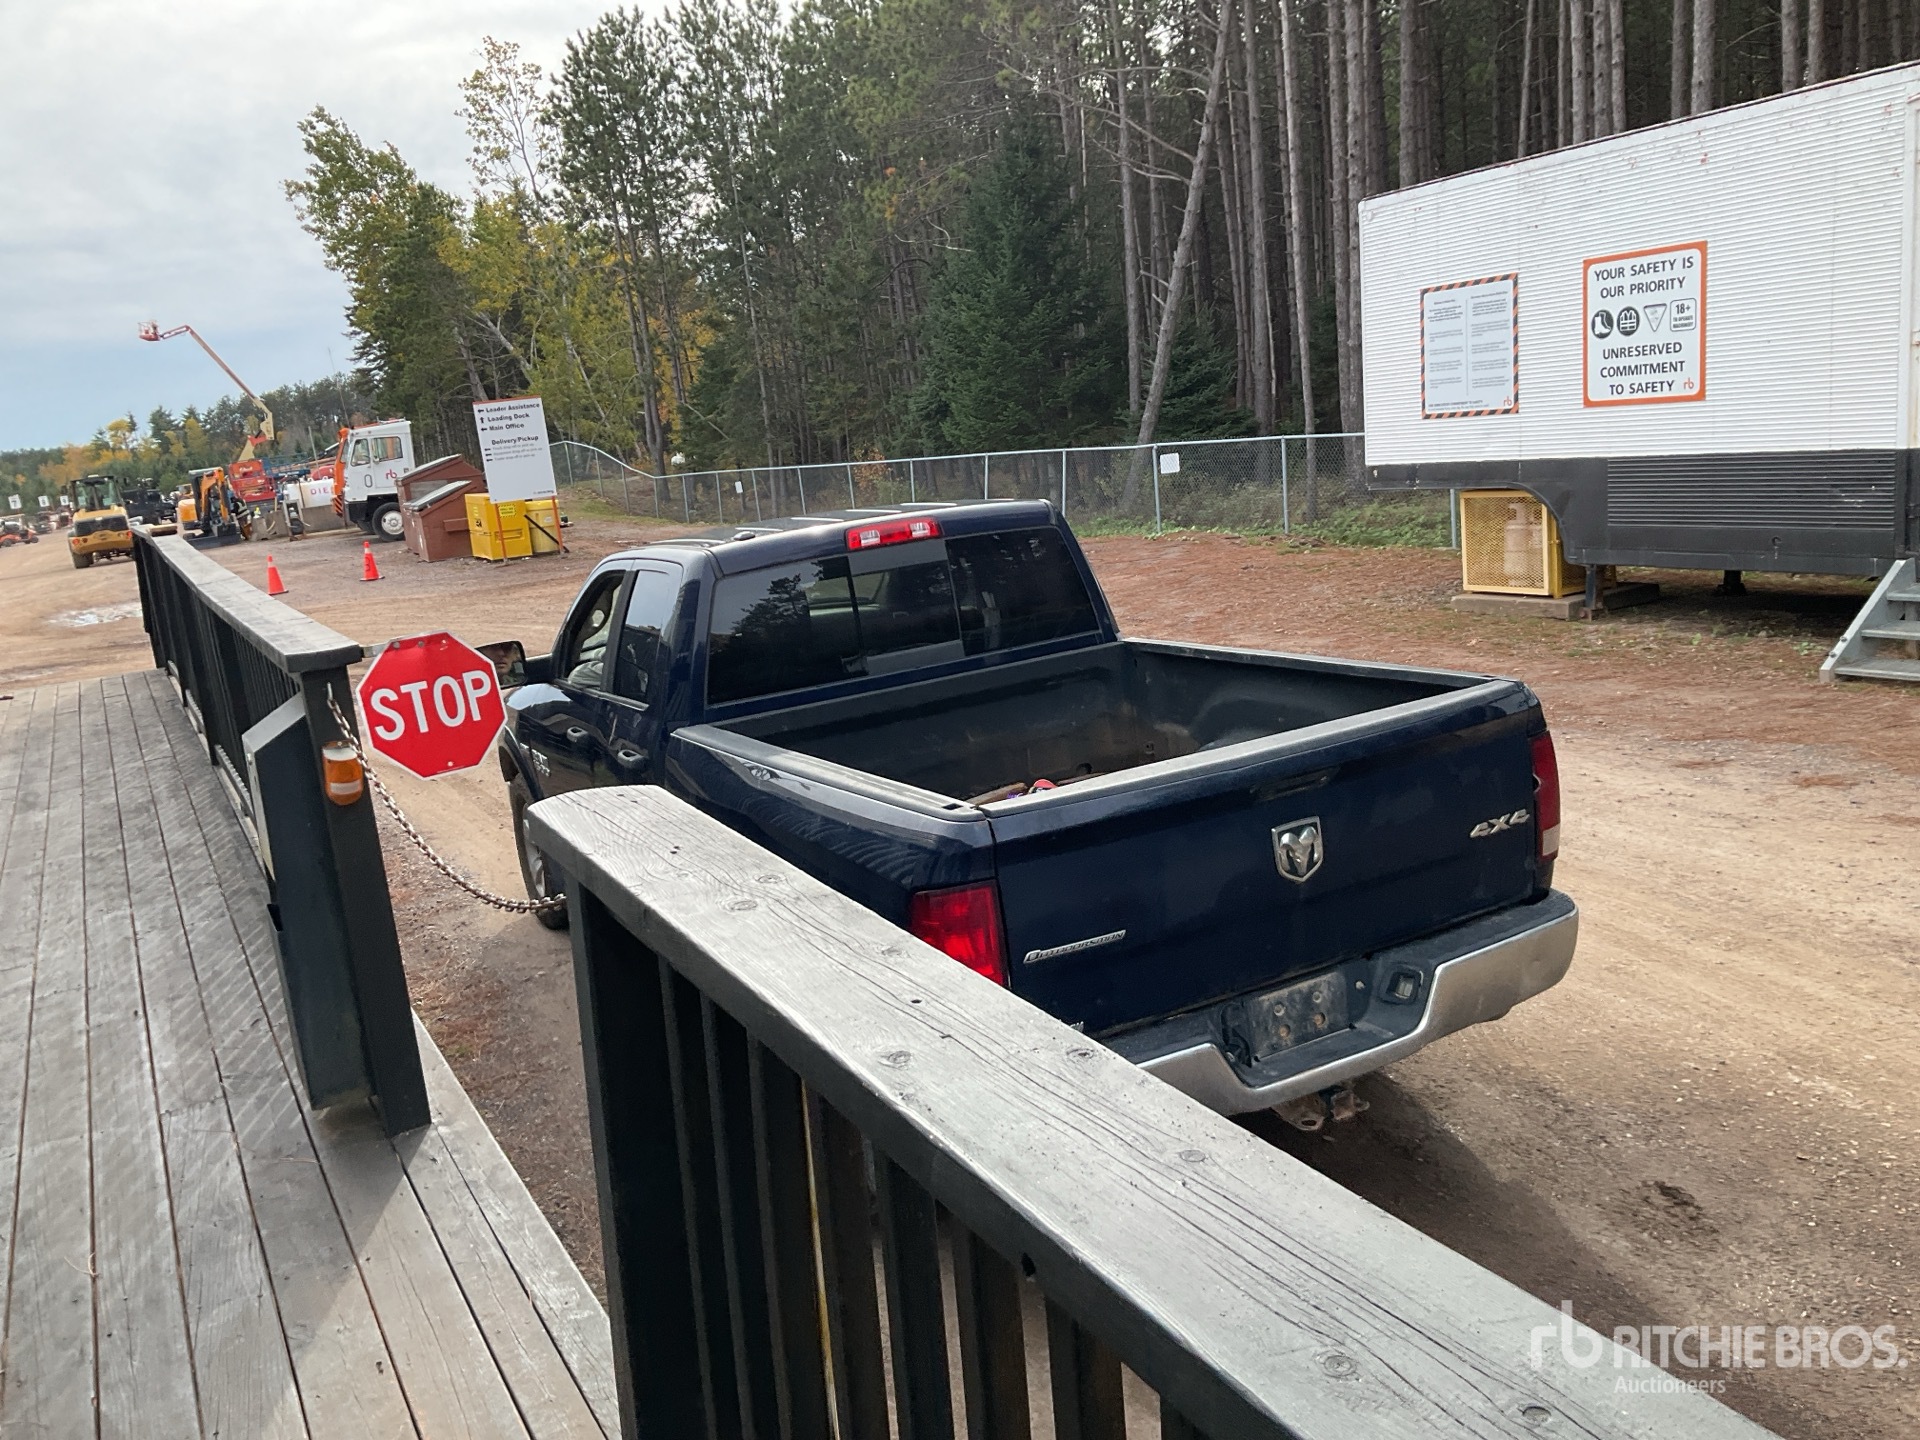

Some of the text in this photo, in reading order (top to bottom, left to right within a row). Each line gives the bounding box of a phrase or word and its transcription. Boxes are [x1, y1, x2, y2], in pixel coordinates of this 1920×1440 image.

[1594, 256, 1694, 282] YOUR SAFETY IS
[1600, 277, 1685, 299] OUR PRIORITY
[1675, 303, 1691, 314] 18+
[1603, 342, 1682, 359] UNRESERVED
[1600, 361, 1685, 378] COMMITMENT
[1610, 377, 1694, 395] TO SAFETY rb
[514, 412, 530, 420] Dock
[370, 670, 492, 741] STOP
